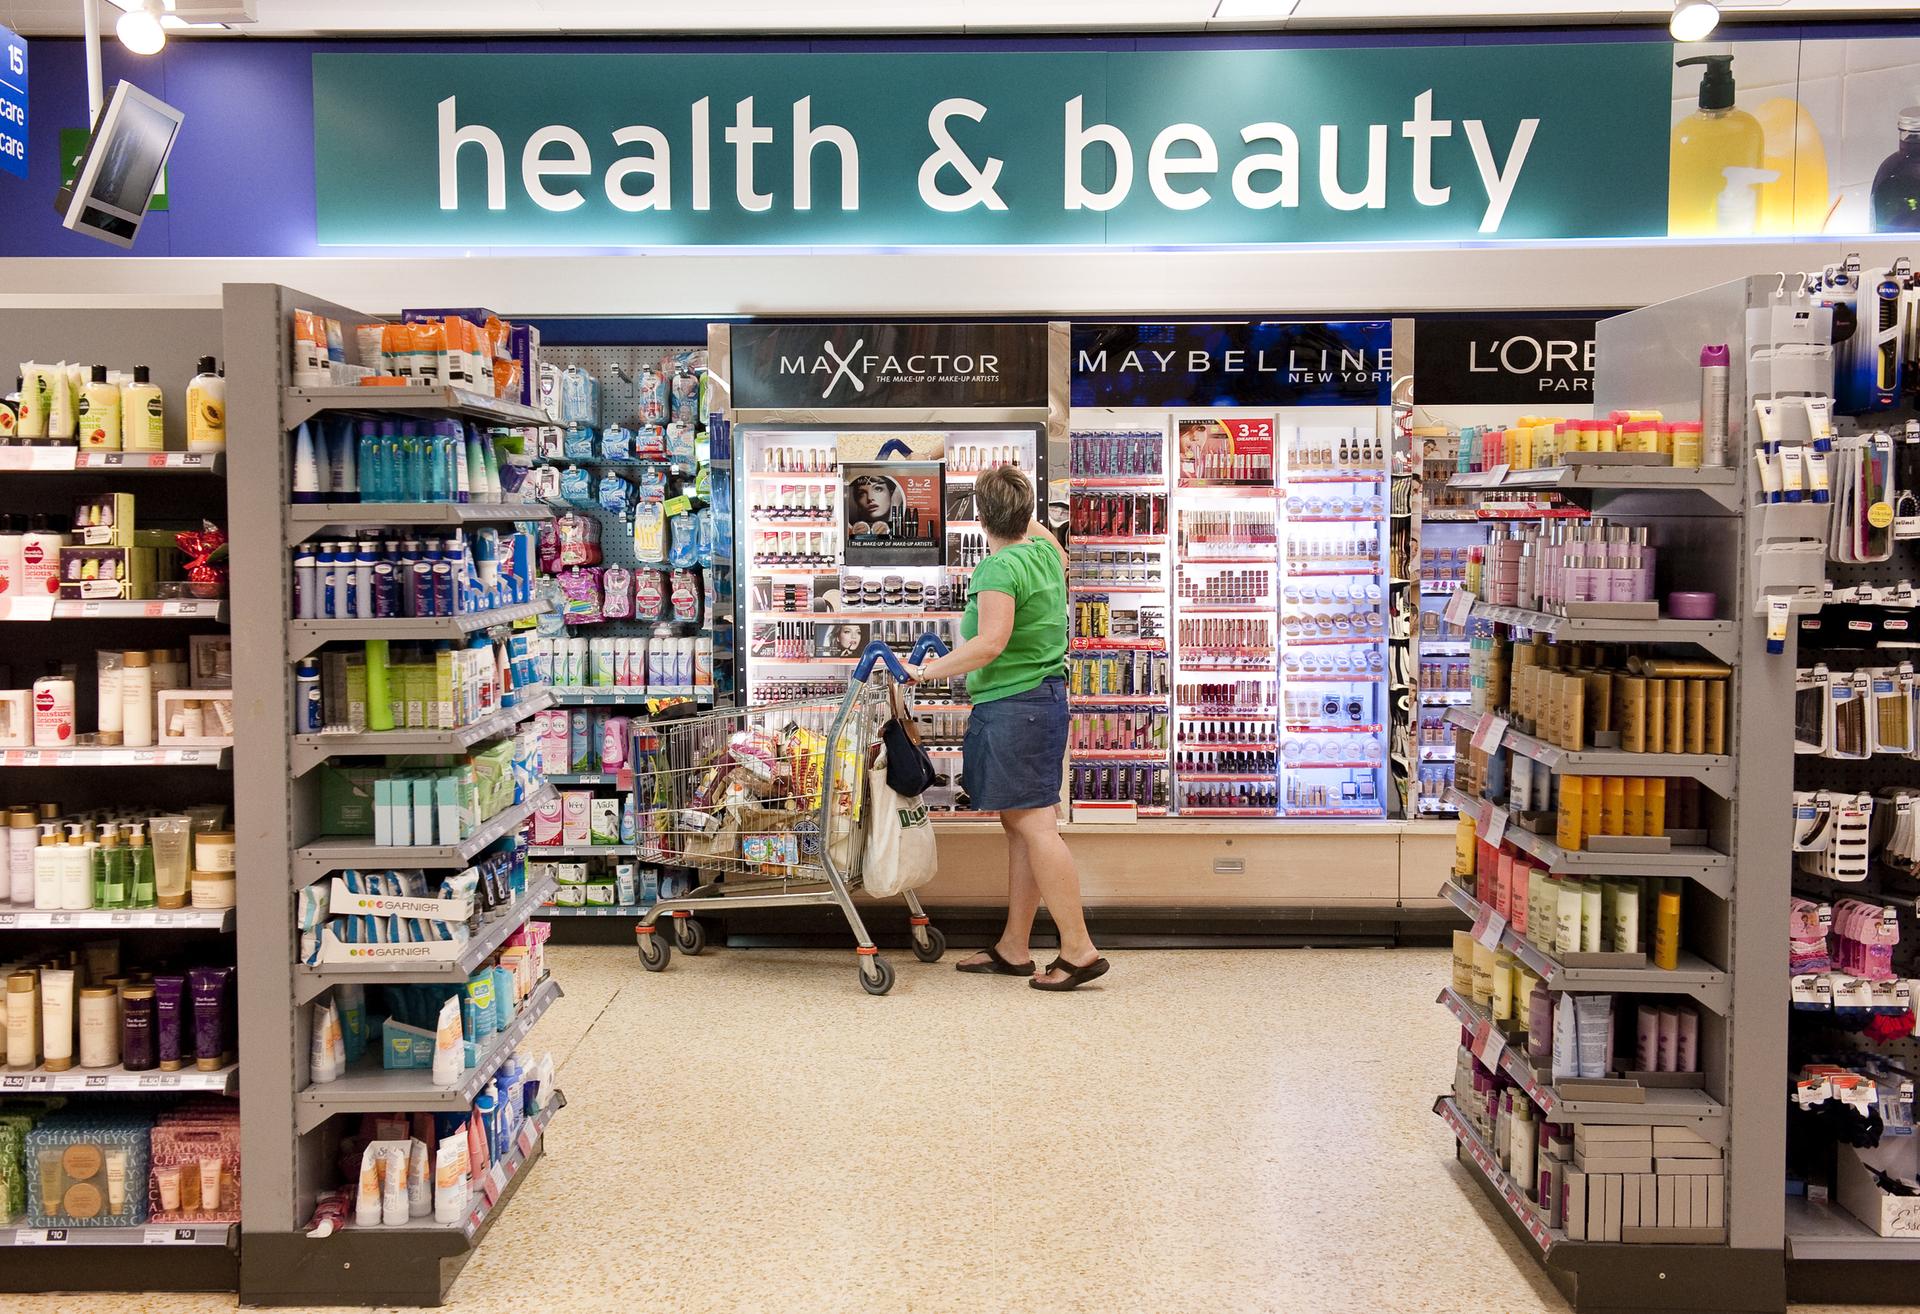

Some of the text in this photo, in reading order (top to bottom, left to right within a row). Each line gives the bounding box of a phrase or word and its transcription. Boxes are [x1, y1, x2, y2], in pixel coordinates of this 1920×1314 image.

[8, 44, 24, 75] 15
[439, 89, 1538, 234] health & beauty
[1079, 349, 1392, 372] MAYBELLINE
[1288, 373, 1333, 383] NEW
[1238, 424, 1250, 436] 3
[1258, 424, 1269, 436] 2
[907, 478, 914, 487] 3
[924, 478, 931, 487] 2
[384, 901, 440, 912] GARNIER
[376, 948, 430, 956] GARNIER
[36, 1134, 128, 1145] CHAMPNEYS
[50, 1230, 62, 1239] £10
[179, 1230, 190, 1238] £10
